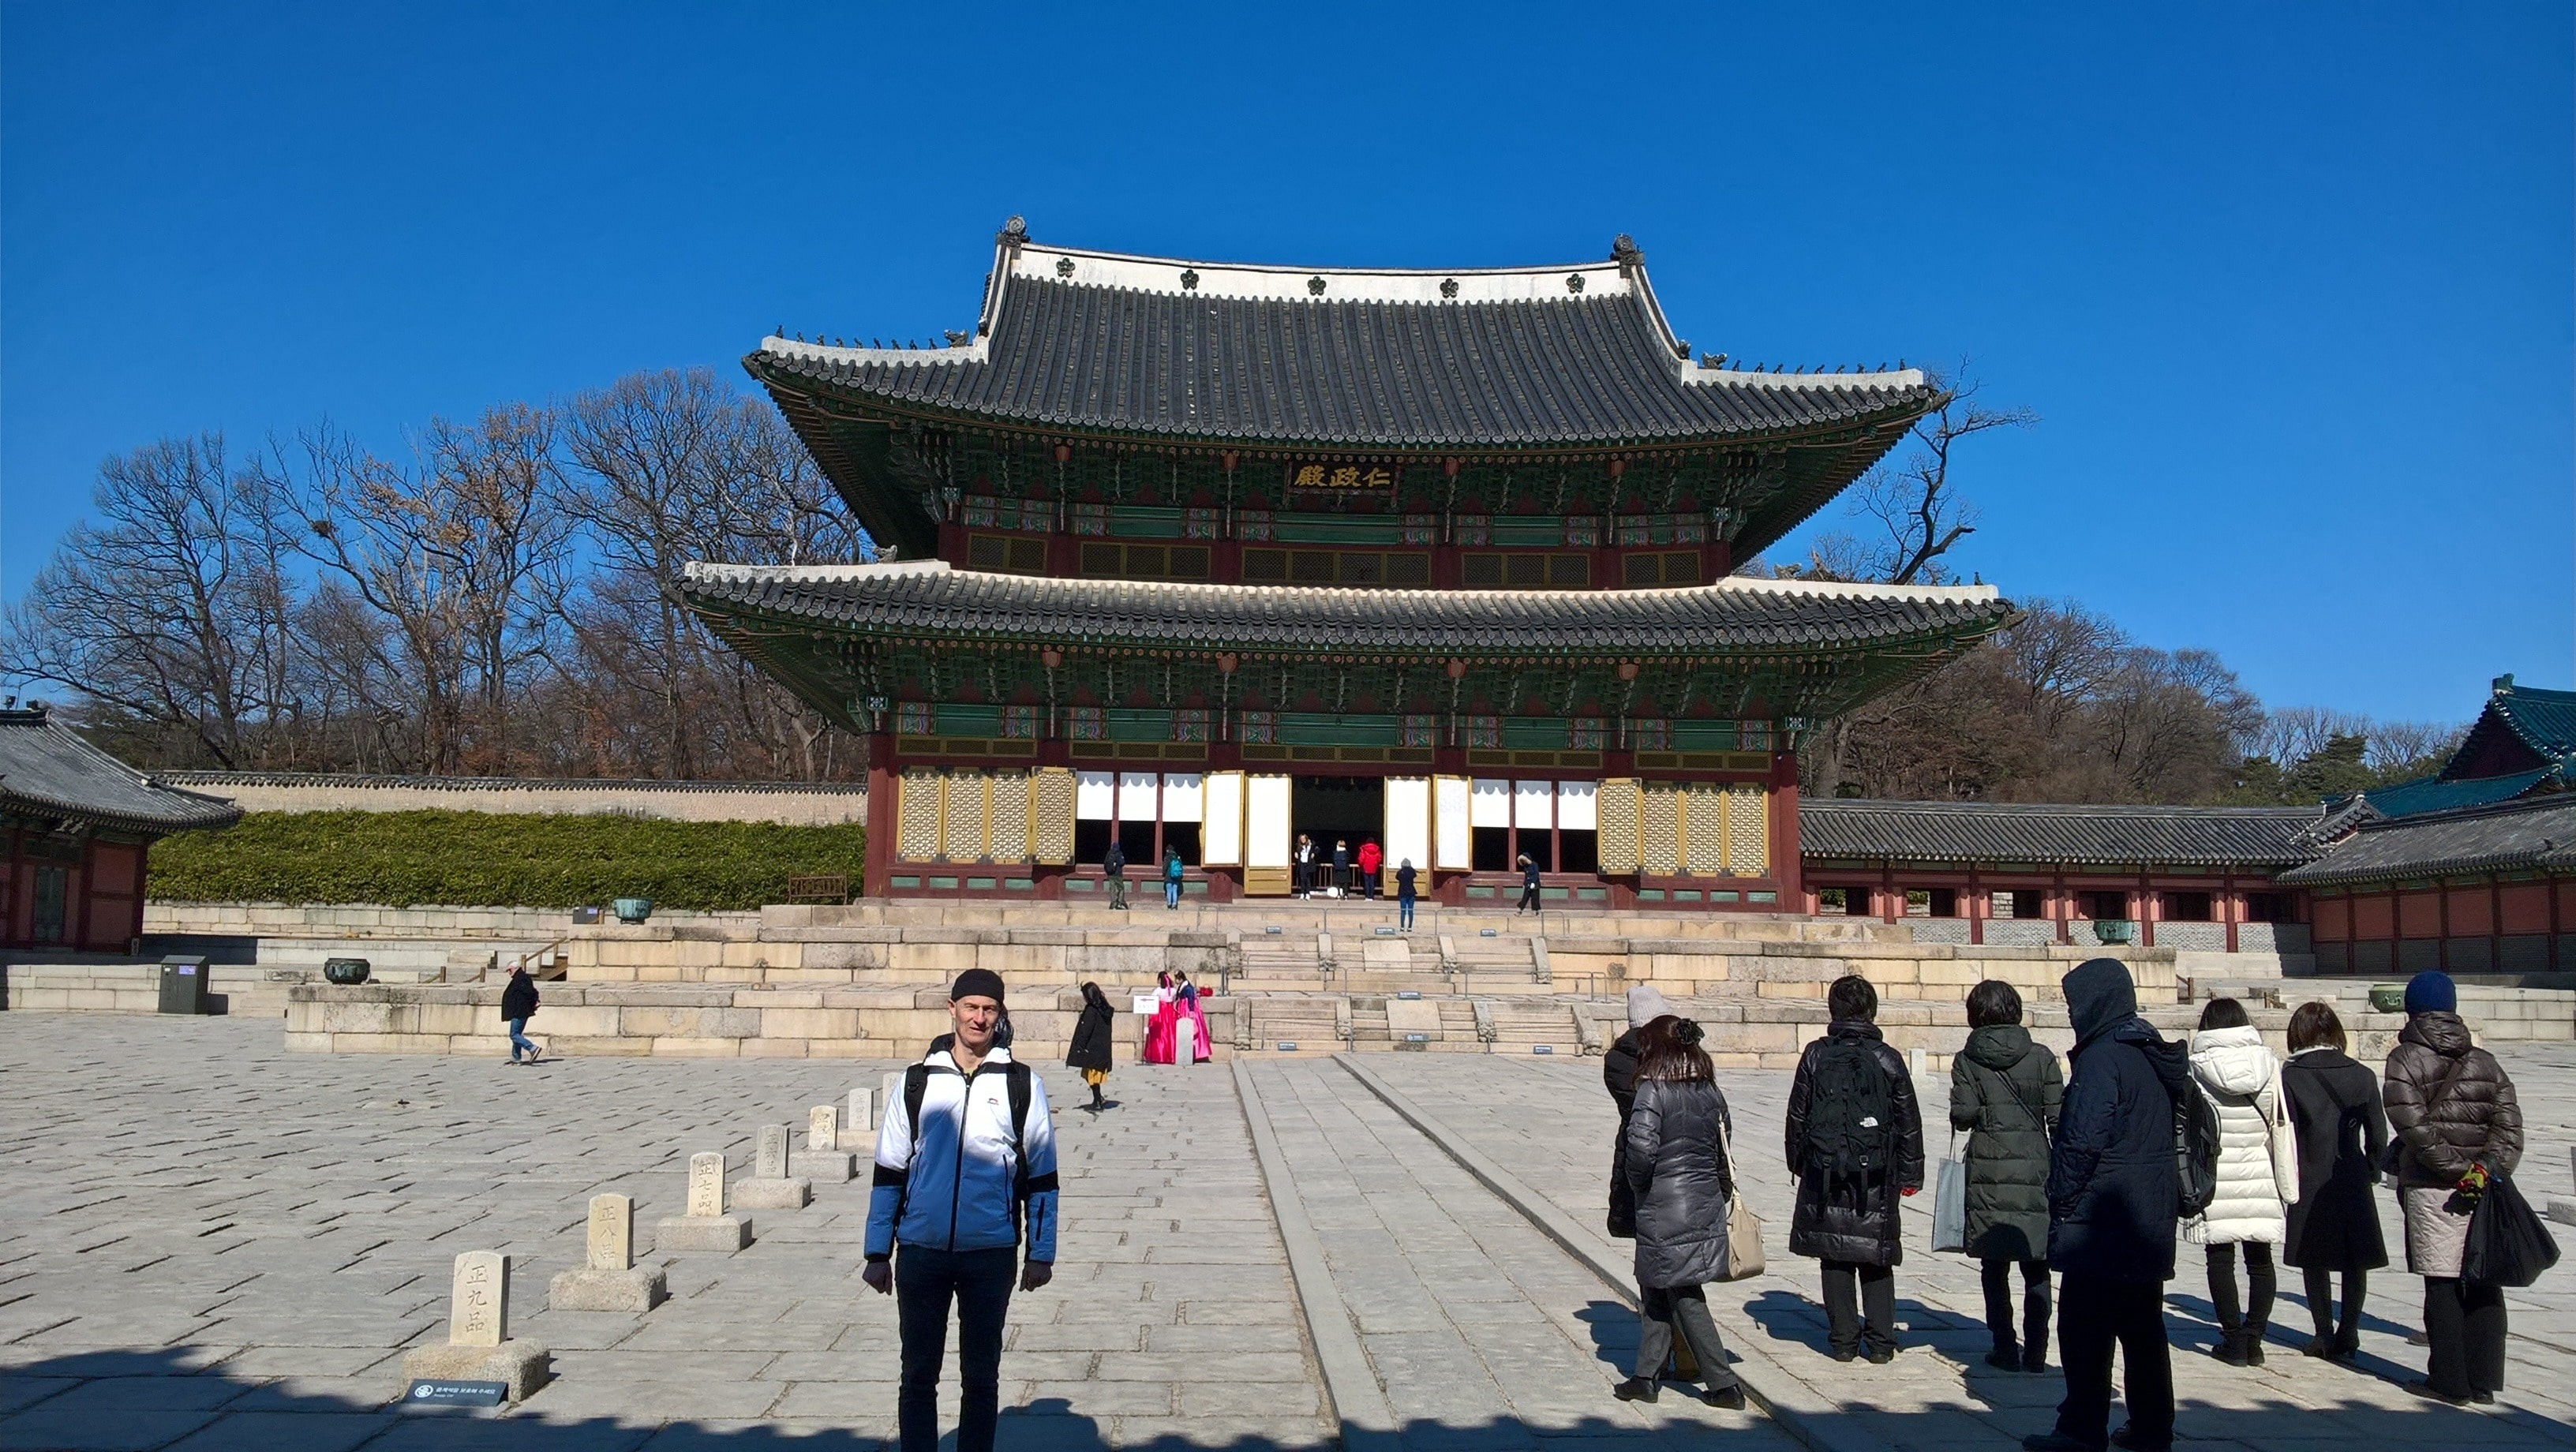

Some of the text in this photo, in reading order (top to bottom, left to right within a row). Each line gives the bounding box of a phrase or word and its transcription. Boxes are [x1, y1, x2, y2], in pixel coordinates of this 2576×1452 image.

[698, 1162, 713, 1208] 正七品
[598, 1205, 617, 1259] 正八品
[465, 1264, 488, 1334] 正九品
